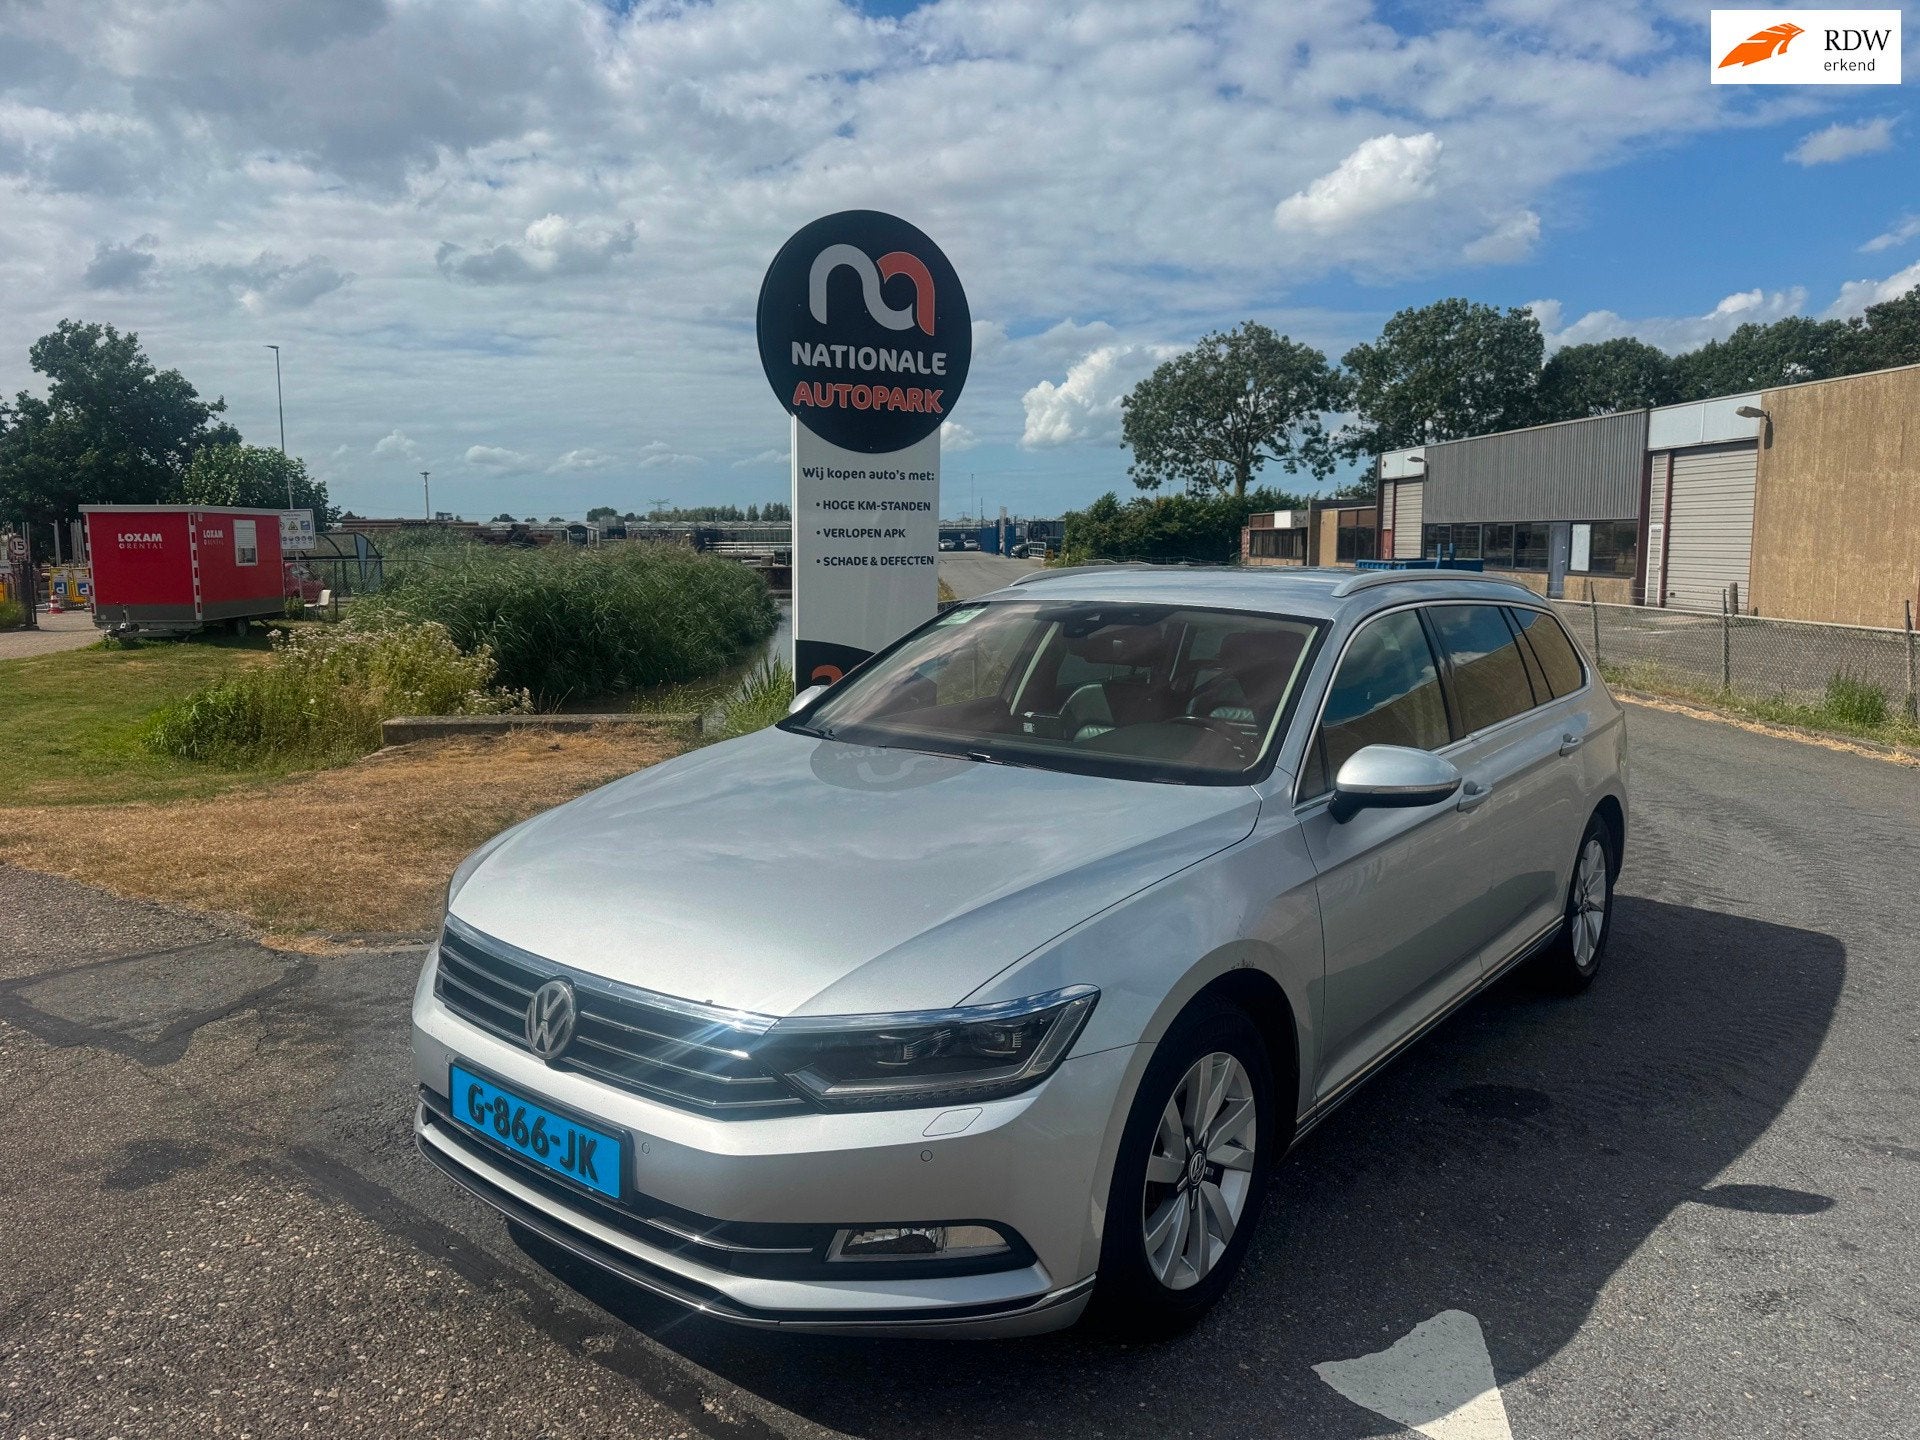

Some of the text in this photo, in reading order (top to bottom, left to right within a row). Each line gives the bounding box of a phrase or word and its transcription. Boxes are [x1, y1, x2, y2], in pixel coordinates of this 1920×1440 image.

[791, 341, 947, 376] NATIONALE
[792, 380, 943, 414] AUTOPARK
[802, 467, 935, 481] Wij kopen auto's met:
[823, 500, 931, 511] HOGE KM-STANDEN
[117, 533, 163, 543] LOXAM
[203, 530, 224, 539] LOXAM
[823, 528, 906, 538] VERLOPEN APK
[13, 541, 25, 551] 15
[823, 556, 935, 566] SCHADE & DEFECTEN
[467, 1084, 599, 1183] G-866-JK
